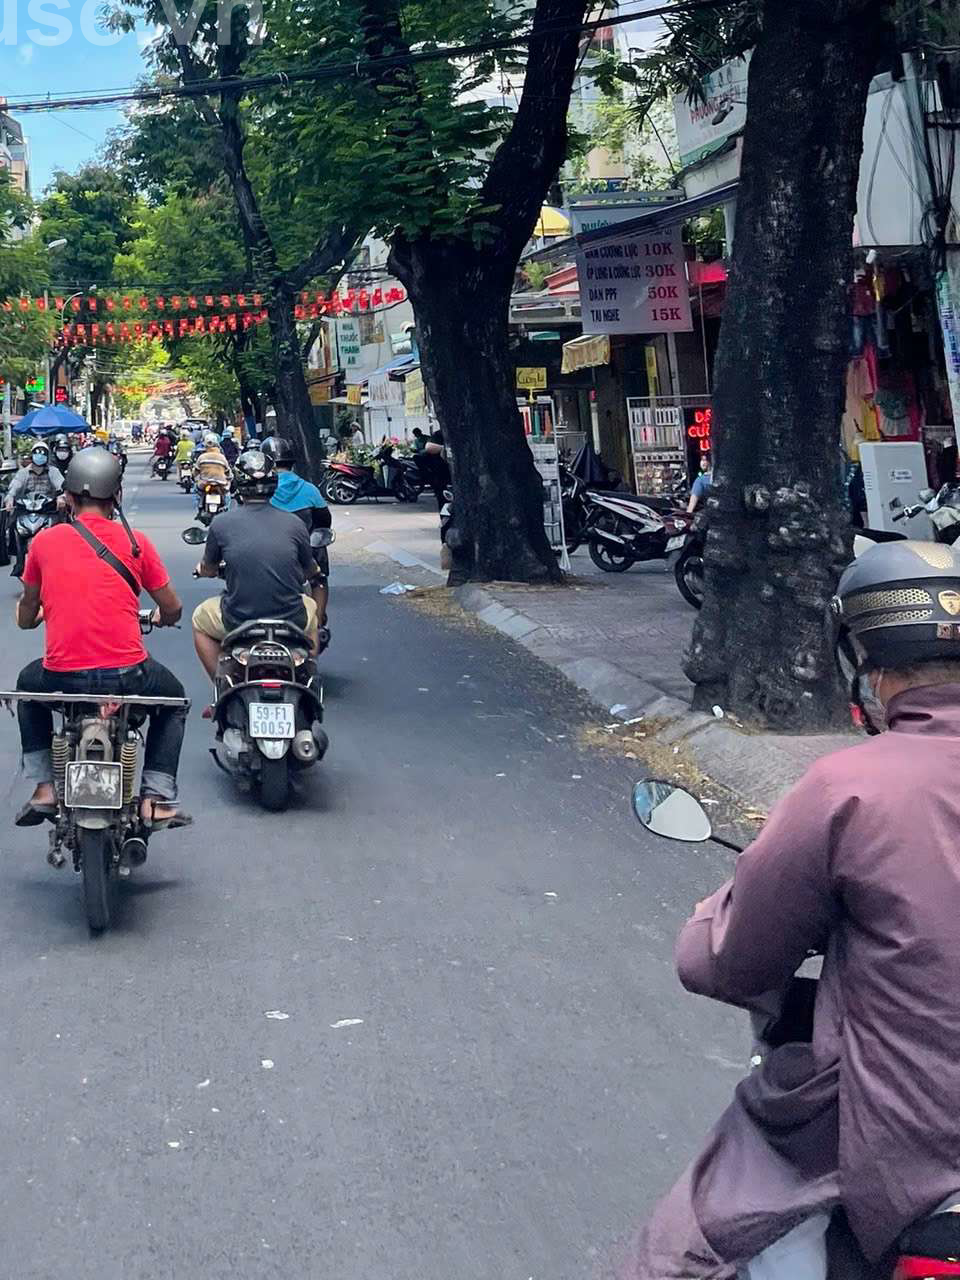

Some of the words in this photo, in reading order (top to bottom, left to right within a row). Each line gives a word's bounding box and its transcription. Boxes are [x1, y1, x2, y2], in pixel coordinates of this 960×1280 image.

[644, 242, 674, 257] 10K
[645, 264, 677, 278] 30K
[648, 285, 679, 300] 50K
[652, 307, 682, 322] 15K
[256, 706, 287, 721] 59-F1
[253, 721, 292, 736] 500.57
